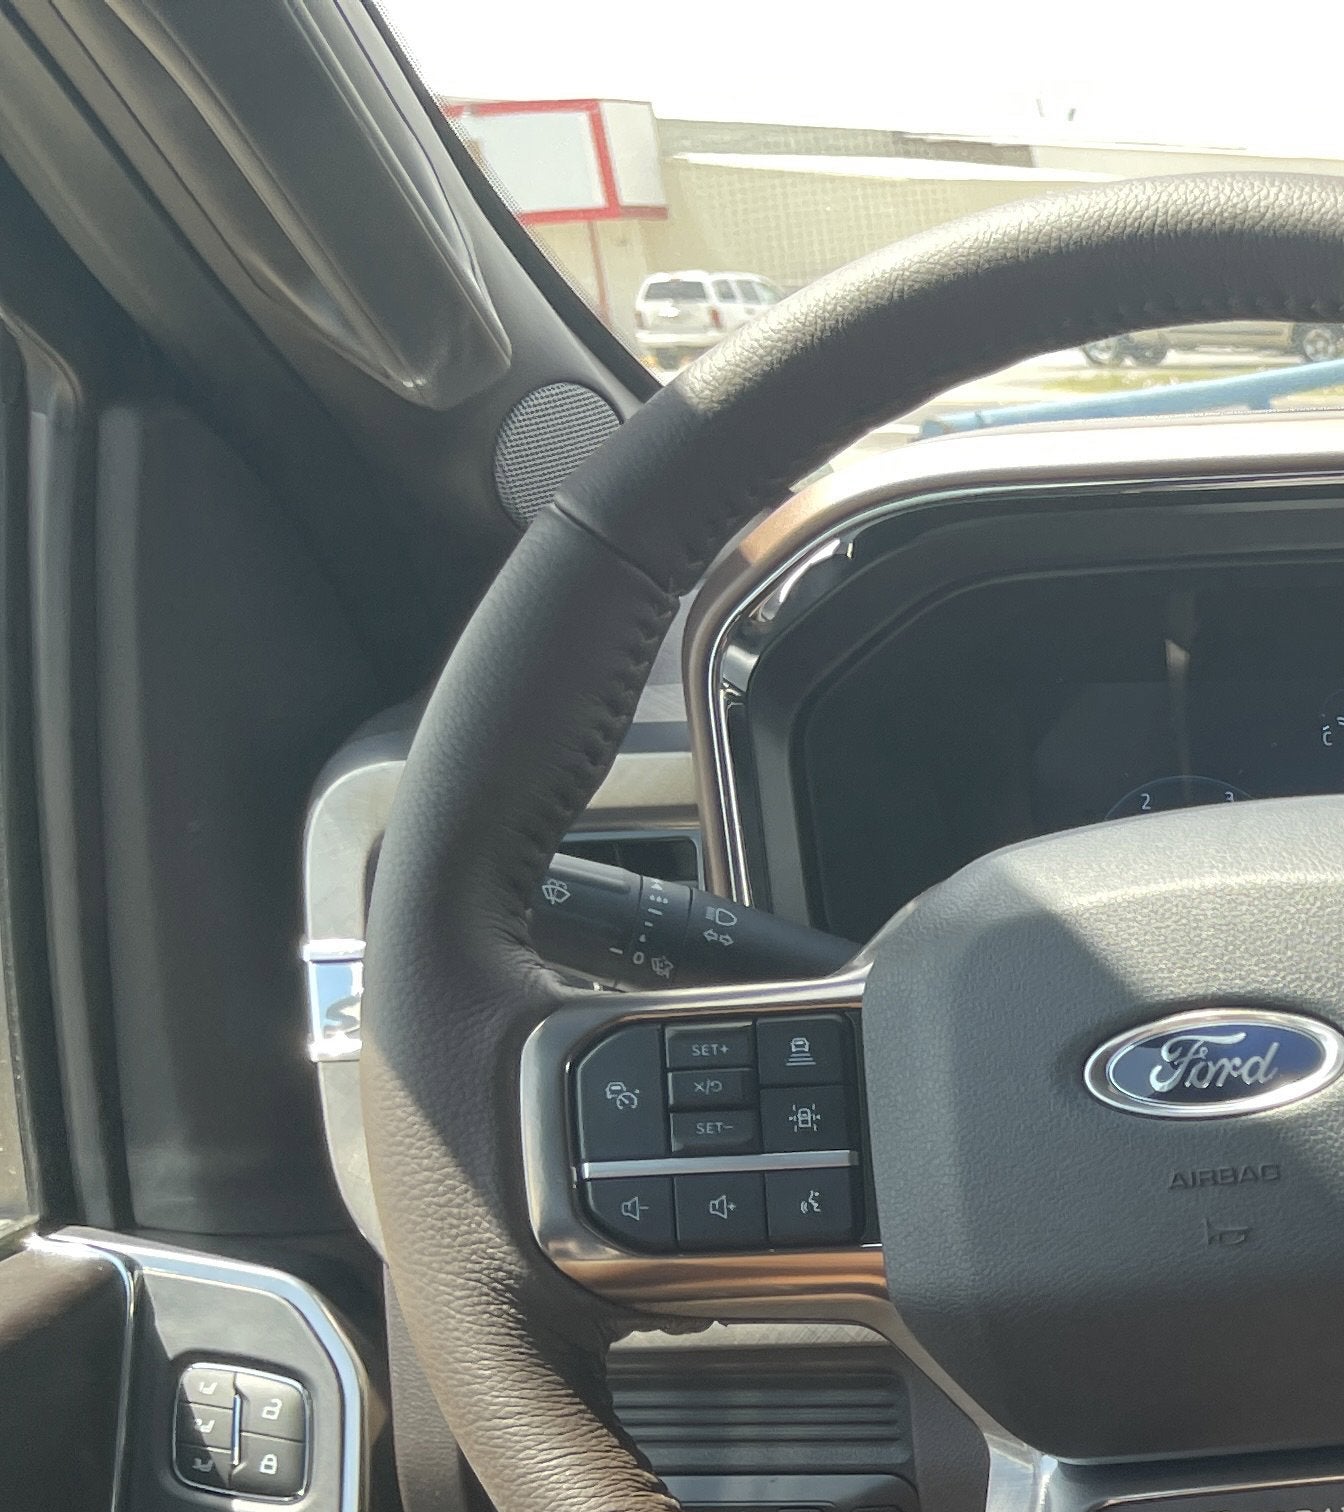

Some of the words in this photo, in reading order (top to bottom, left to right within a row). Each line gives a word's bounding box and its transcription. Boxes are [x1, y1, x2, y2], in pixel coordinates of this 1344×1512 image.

[1323, 731, 1333, 746] C
[1140, 793, 1152, 810] 2
[1149, 1032, 1280, 1093] Ford
[1168, 1163, 1281, 1190] AIRBAG
